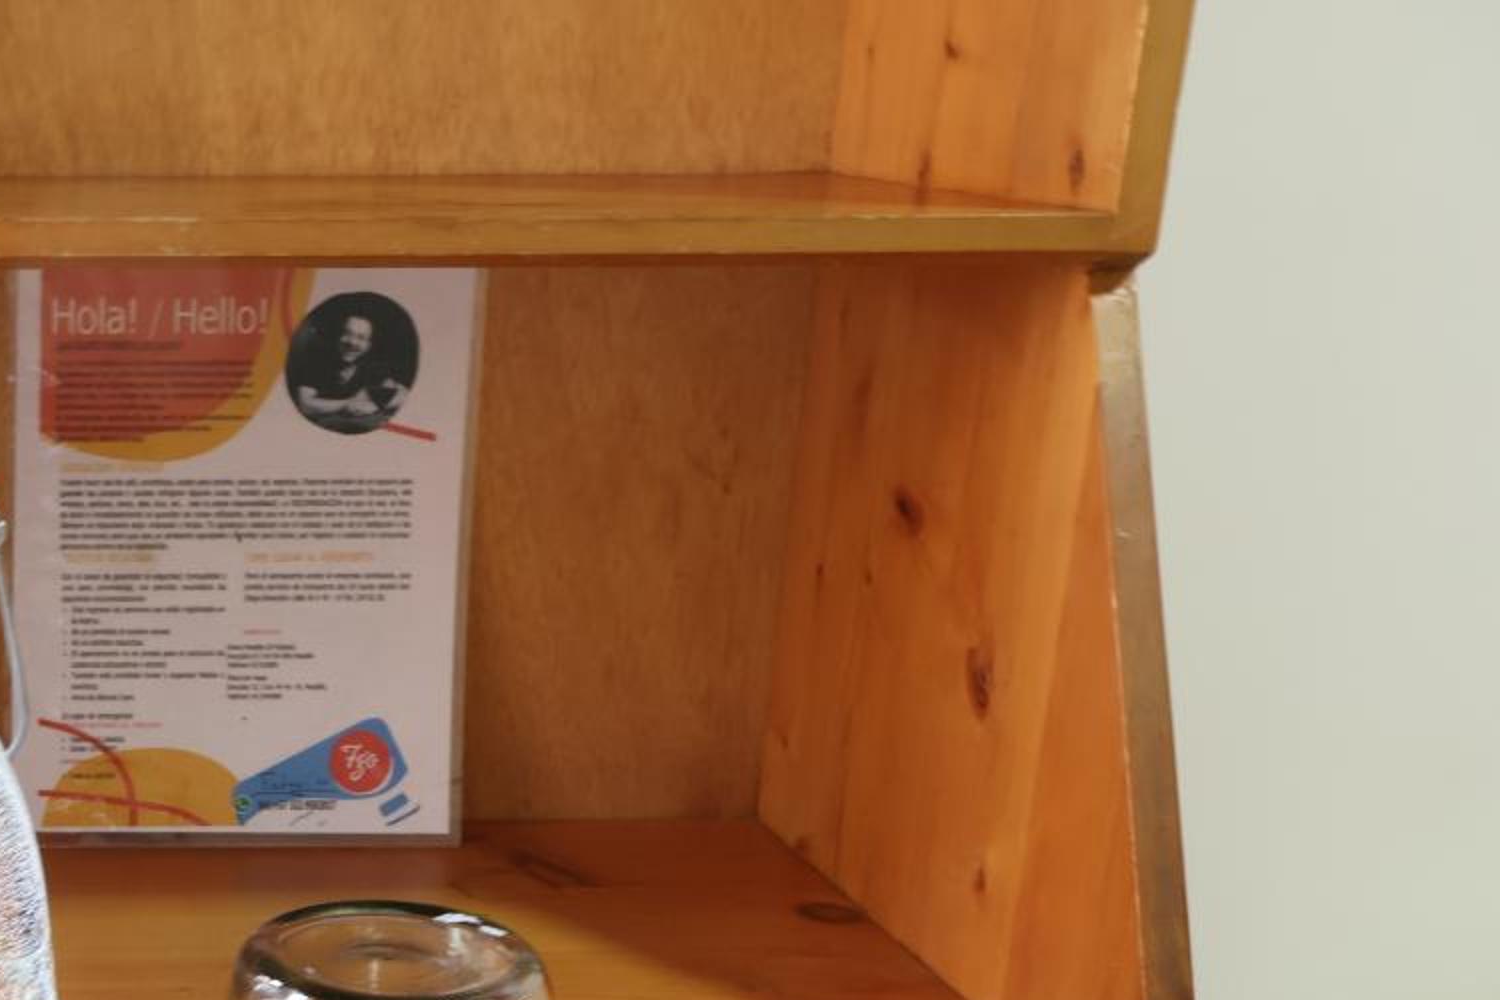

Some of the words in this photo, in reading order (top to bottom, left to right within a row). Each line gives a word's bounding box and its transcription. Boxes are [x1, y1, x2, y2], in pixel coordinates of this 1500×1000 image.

[51, 296, 138, 336] Hola!
[148, 301, 165, 340] /
[171, 296, 269, 336] Hello!
